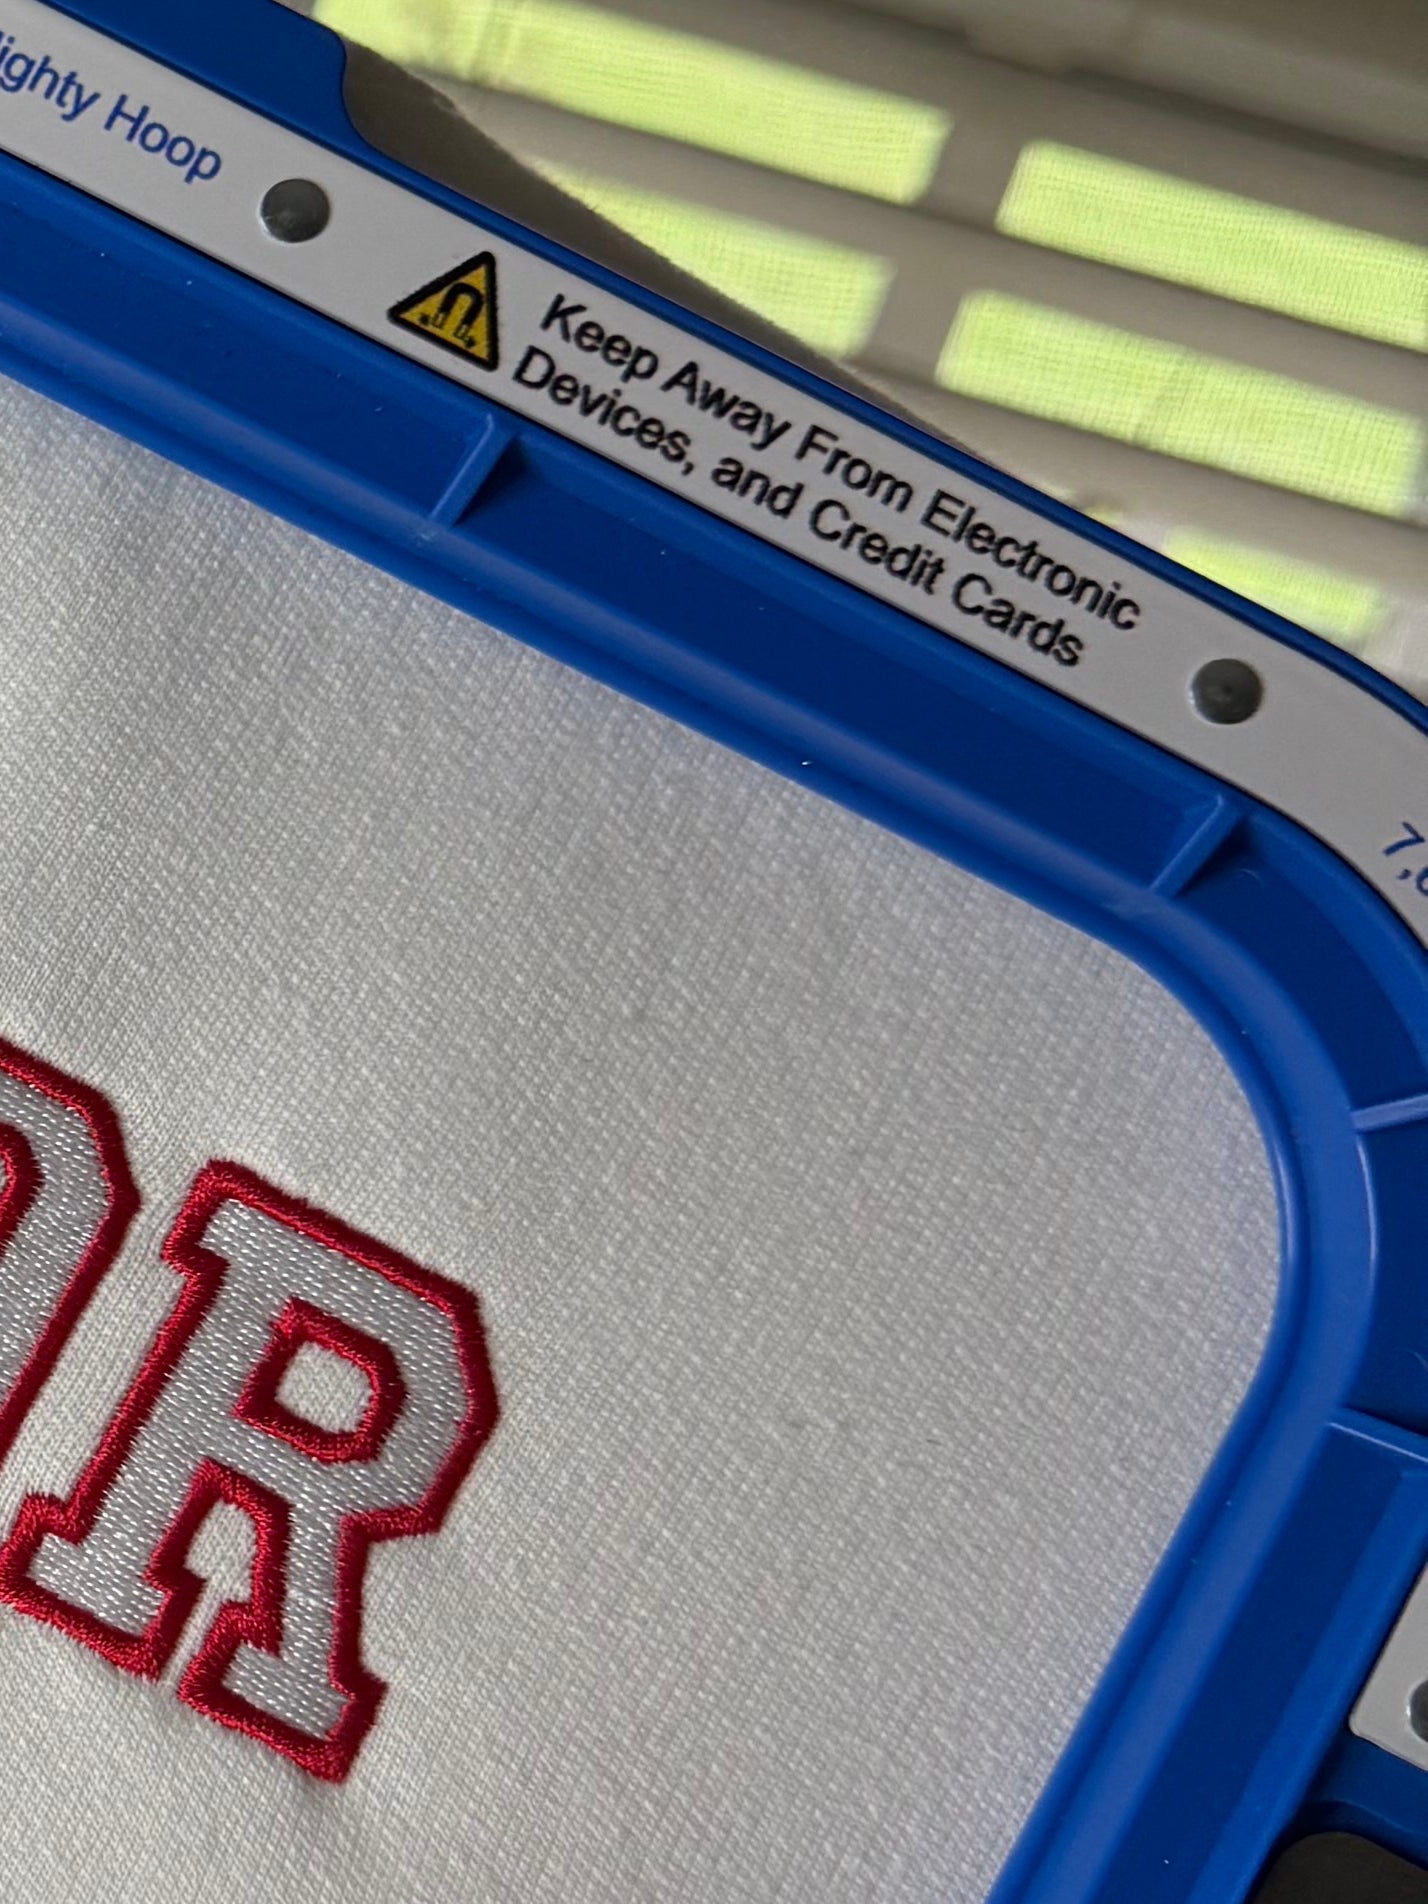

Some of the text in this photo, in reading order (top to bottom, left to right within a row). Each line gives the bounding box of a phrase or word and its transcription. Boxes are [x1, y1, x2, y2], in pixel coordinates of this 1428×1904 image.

[103, 93, 223, 185] Hoop
[511, 344, 1085, 668] Devices, and Credit Cards
[539, 292, 1141, 631] Keep Away From Electronic
